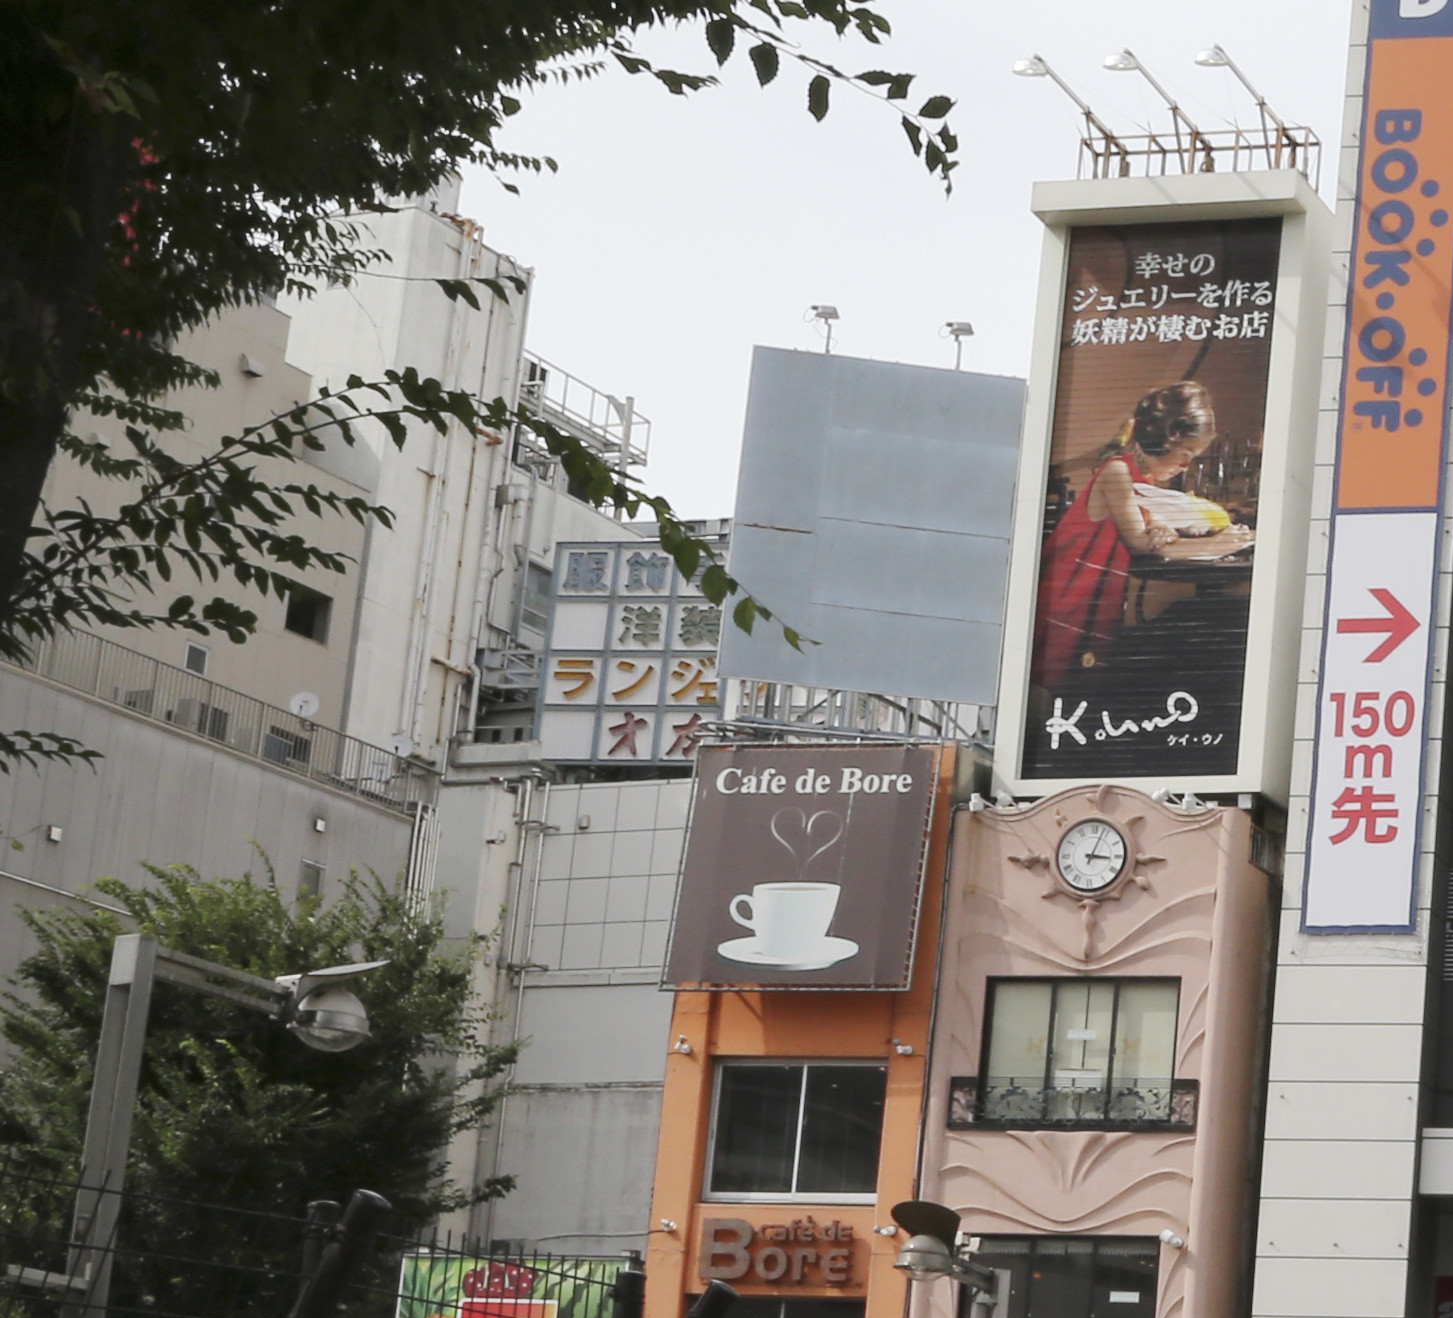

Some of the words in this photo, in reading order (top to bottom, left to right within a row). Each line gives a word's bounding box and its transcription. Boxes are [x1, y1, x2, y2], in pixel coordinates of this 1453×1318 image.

[1135, 252, 1216, 279] 幸せの
[1072, 280, 1272, 312] ジュエリーを作る
[1070, 311, 1270, 346] 妖精が棲むお店
[1167, 733, 1223, 746] ケイ・ウノ
[716, 767, 787, 794] Cafe
[795, 768, 831, 793] de
[838, 767, 913, 794] Bore
